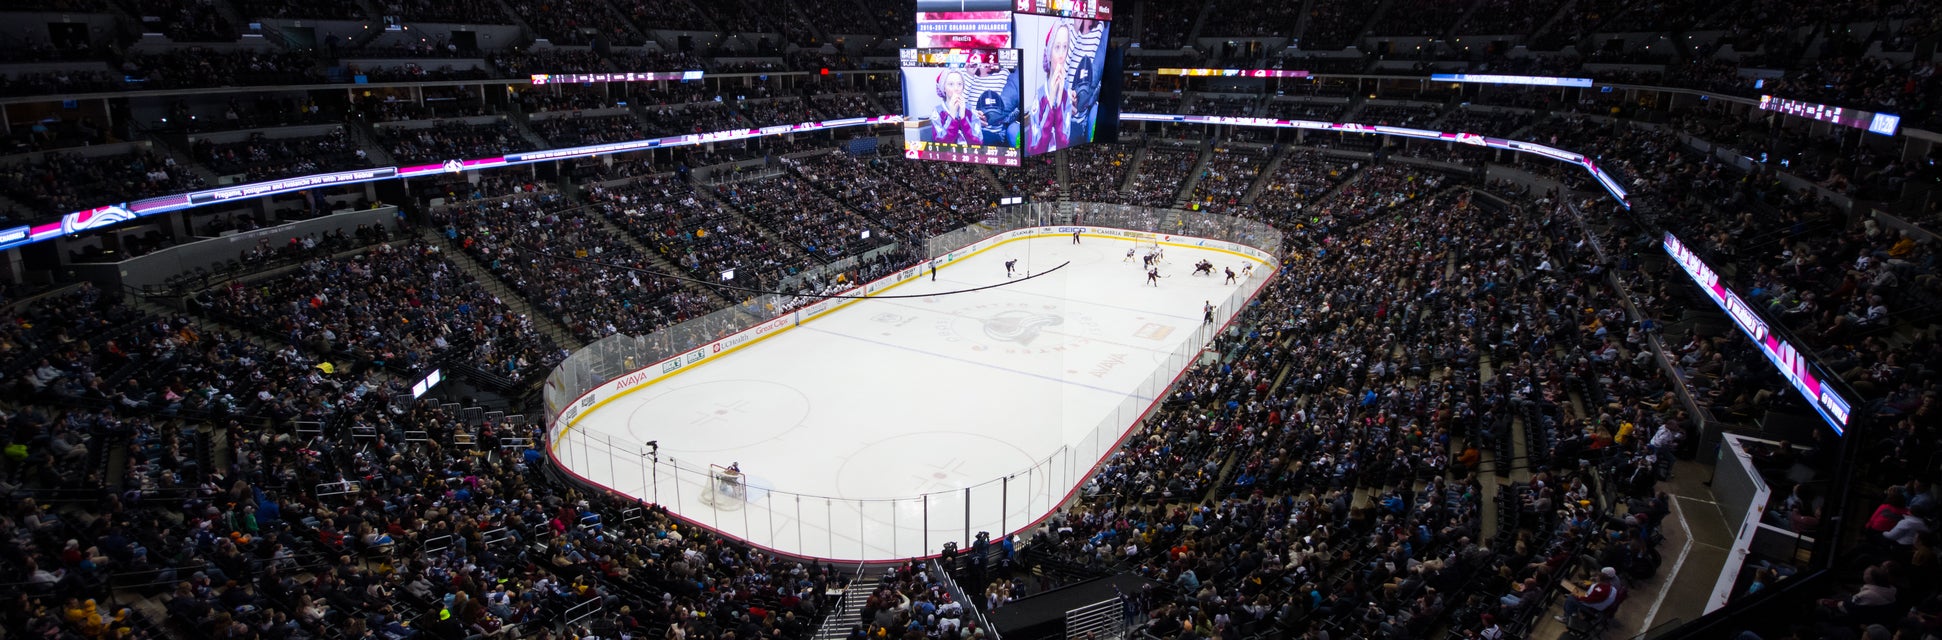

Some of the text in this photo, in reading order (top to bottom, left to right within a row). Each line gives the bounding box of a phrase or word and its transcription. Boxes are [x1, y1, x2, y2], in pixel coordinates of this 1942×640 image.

[989, 54, 994, 63] 2
[214, 190, 242, 199] Pregame,
[243, 186, 271, 195] postgame
[322, 174, 337, 182] with
[1096, 228, 1121, 236] CAMBRIA
[755, 318, 789, 335] Great Clips
[616, 371, 648, 390] AVAYA
